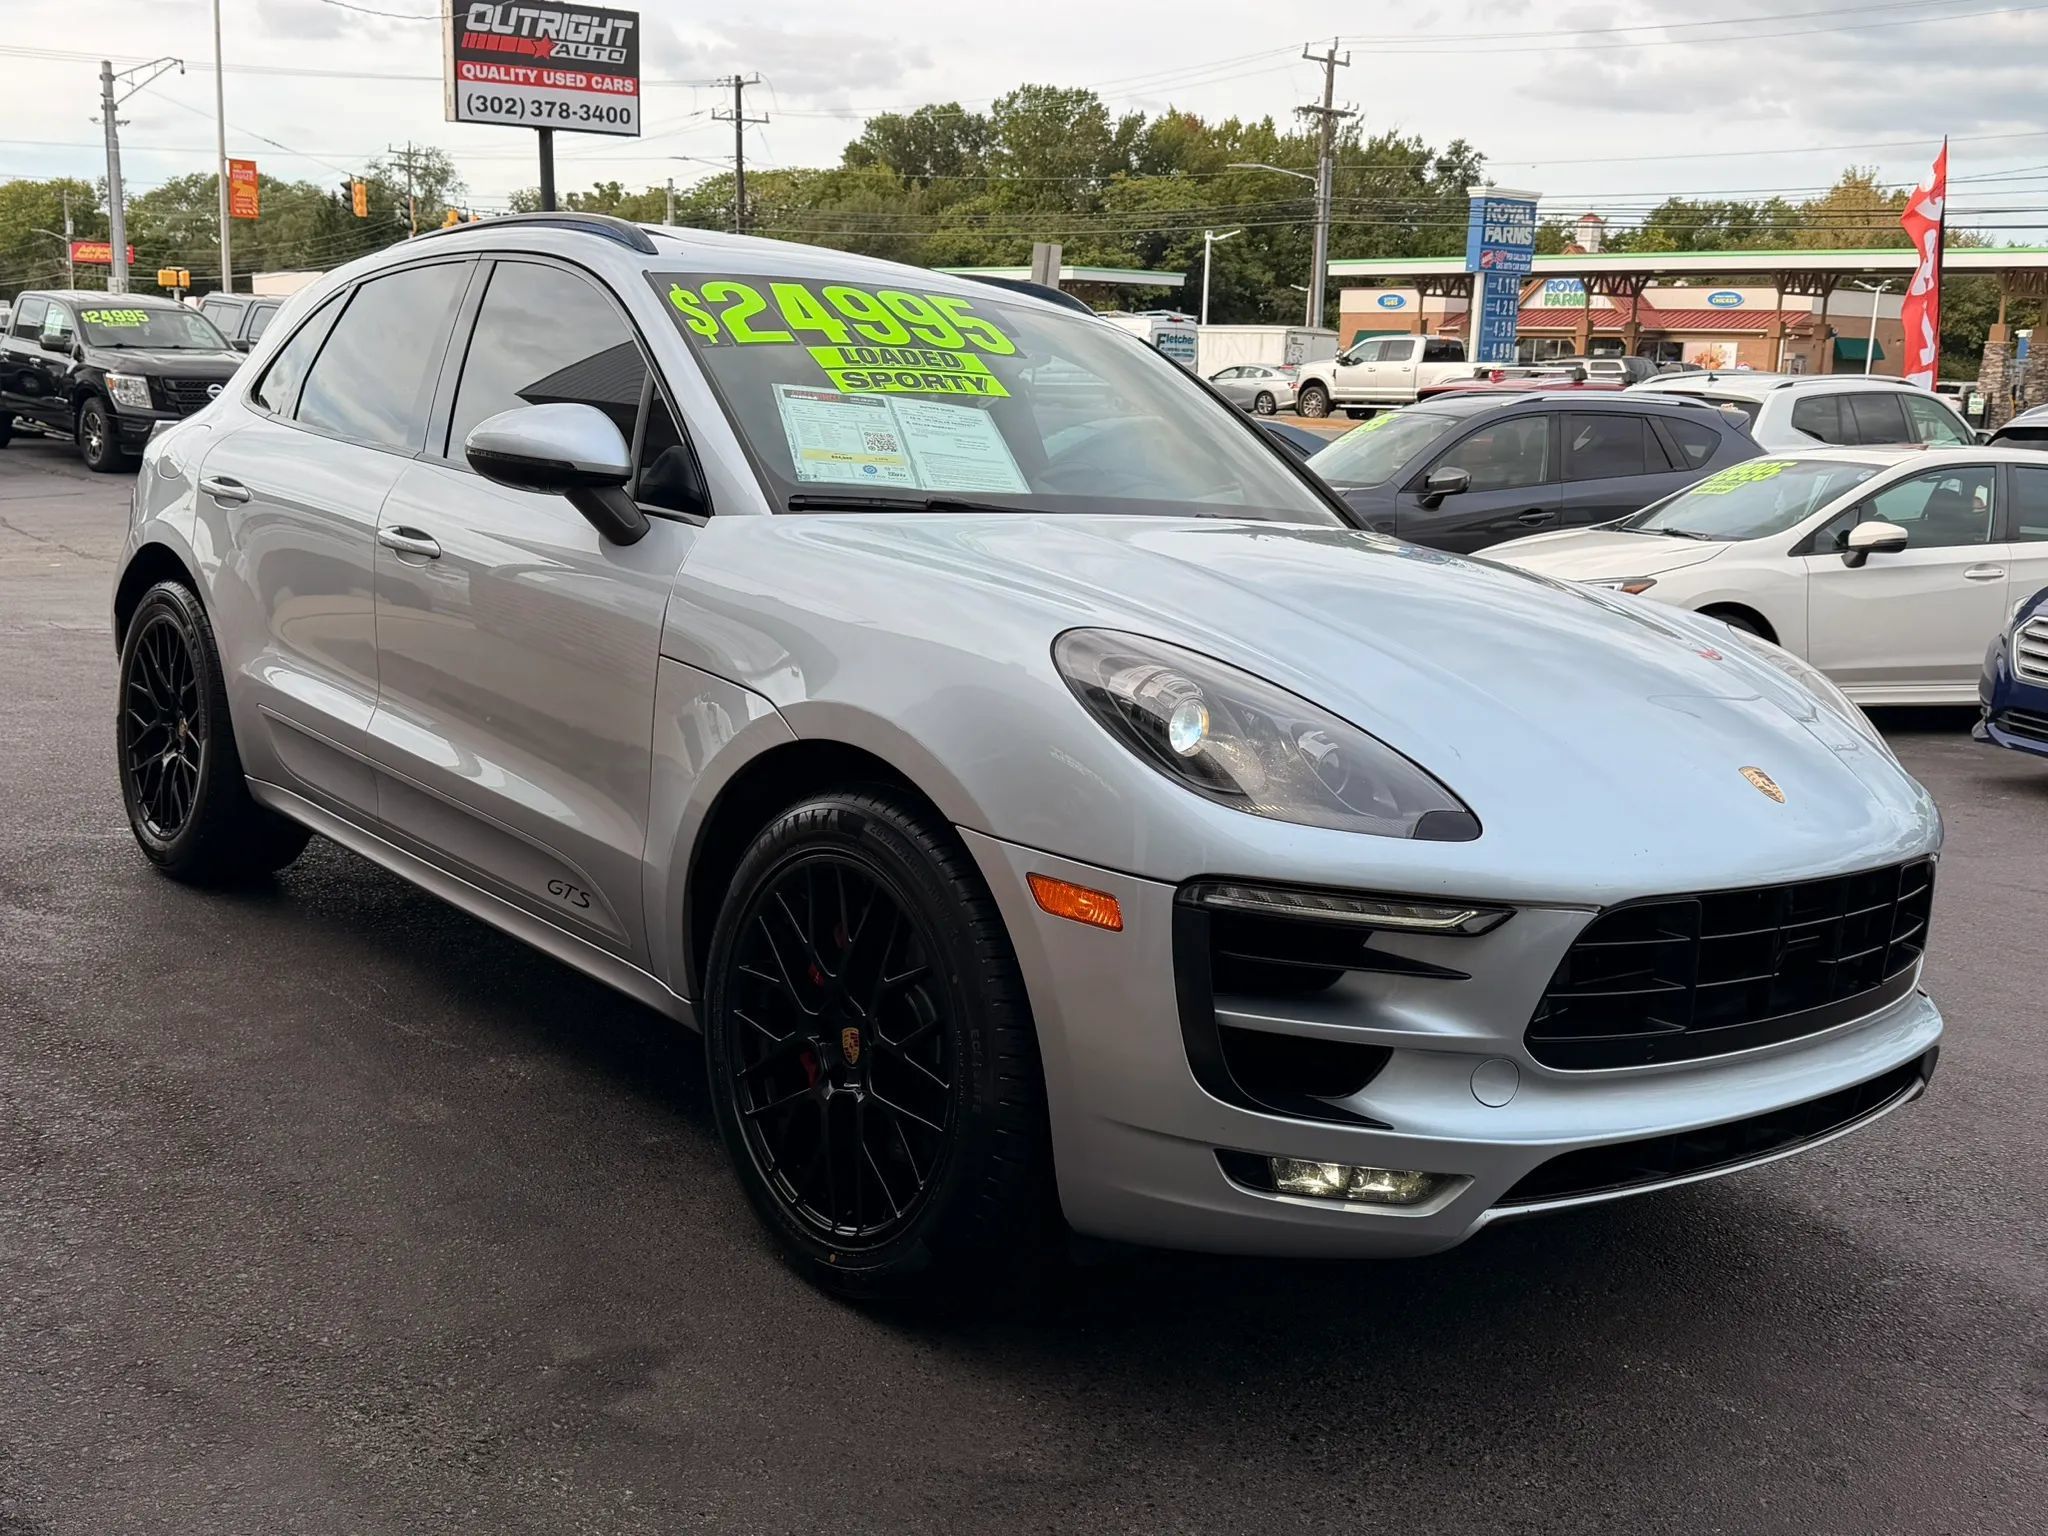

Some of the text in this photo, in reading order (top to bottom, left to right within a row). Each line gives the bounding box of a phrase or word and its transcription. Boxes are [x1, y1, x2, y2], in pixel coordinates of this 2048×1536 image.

[465, 2, 634, 47] OUTRIGHT
[555, 43, 625, 61] AUTO
[461, 63, 634, 92] QUALITY USED CARS
[467, 93, 631, 125] (302) 378-3400
[1486, 202, 1534, 225] ROYAL
[1484, 223, 1533, 245] FARMS
[1546, 280, 1585, 293] ROYA
[1544, 293, 1585, 306] FARM
[81, 309, 149, 323] $24995
[669, 281, 1016, 356] $24995
[1156, 333, 1195, 348] Fletcher
[840, 347, 966, 371] LOADED
[841, 370, 989, 395] SPORTY
[547, 879, 591, 909] GTS
